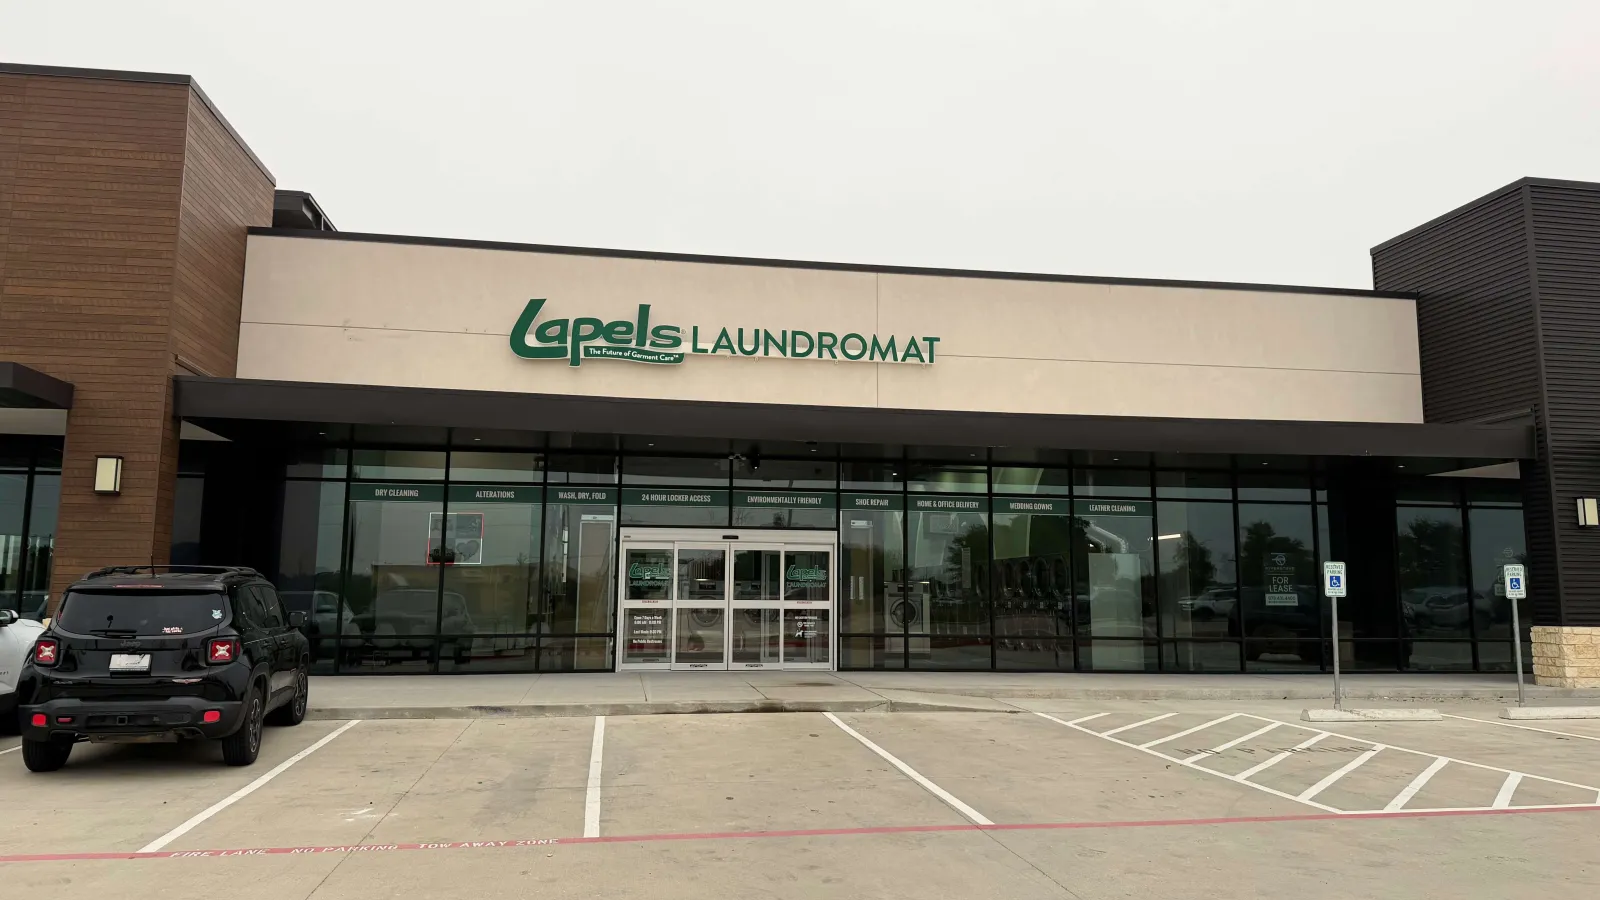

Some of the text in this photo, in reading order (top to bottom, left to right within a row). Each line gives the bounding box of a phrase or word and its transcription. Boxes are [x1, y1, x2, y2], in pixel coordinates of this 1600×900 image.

[509, 298, 941, 367] Lapels LAUNDROMAT
[589, 347, 601, 355] The
[602, 348, 623, 356] Future
[631, 351, 659, 361] Garment
[375, 488, 419, 497] DRY CLEANING
[475, 490, 515, 499] ALTERATIONS
[558, 491, 606, 500] WASH, DRY, FOLD
[641, 493, 650, 501] 24
[667, 494, 689, 502] LOCKER
[689, 495, 711, 503] ACCESS
[747, 495, 822, 504] ENVIRONMENTALLY FRIENDLY
[855, 498, 870, 506] SHOE
[916, 500, 979, 509] HOME & OFFICE DELIVERY
[1009, 502, 1053, 511] WEDDING GOWNS
[1089, 504, 1136, 513] LEATHER CLEANING
[1272, 576, 1289, 585] FOR
[1269, 584, 1293, 593] LEASE
[218, 848, 267, 857] LANE
[321, 844, 399, 853] PARKING
[515, 838, 559, 846] ZONE
